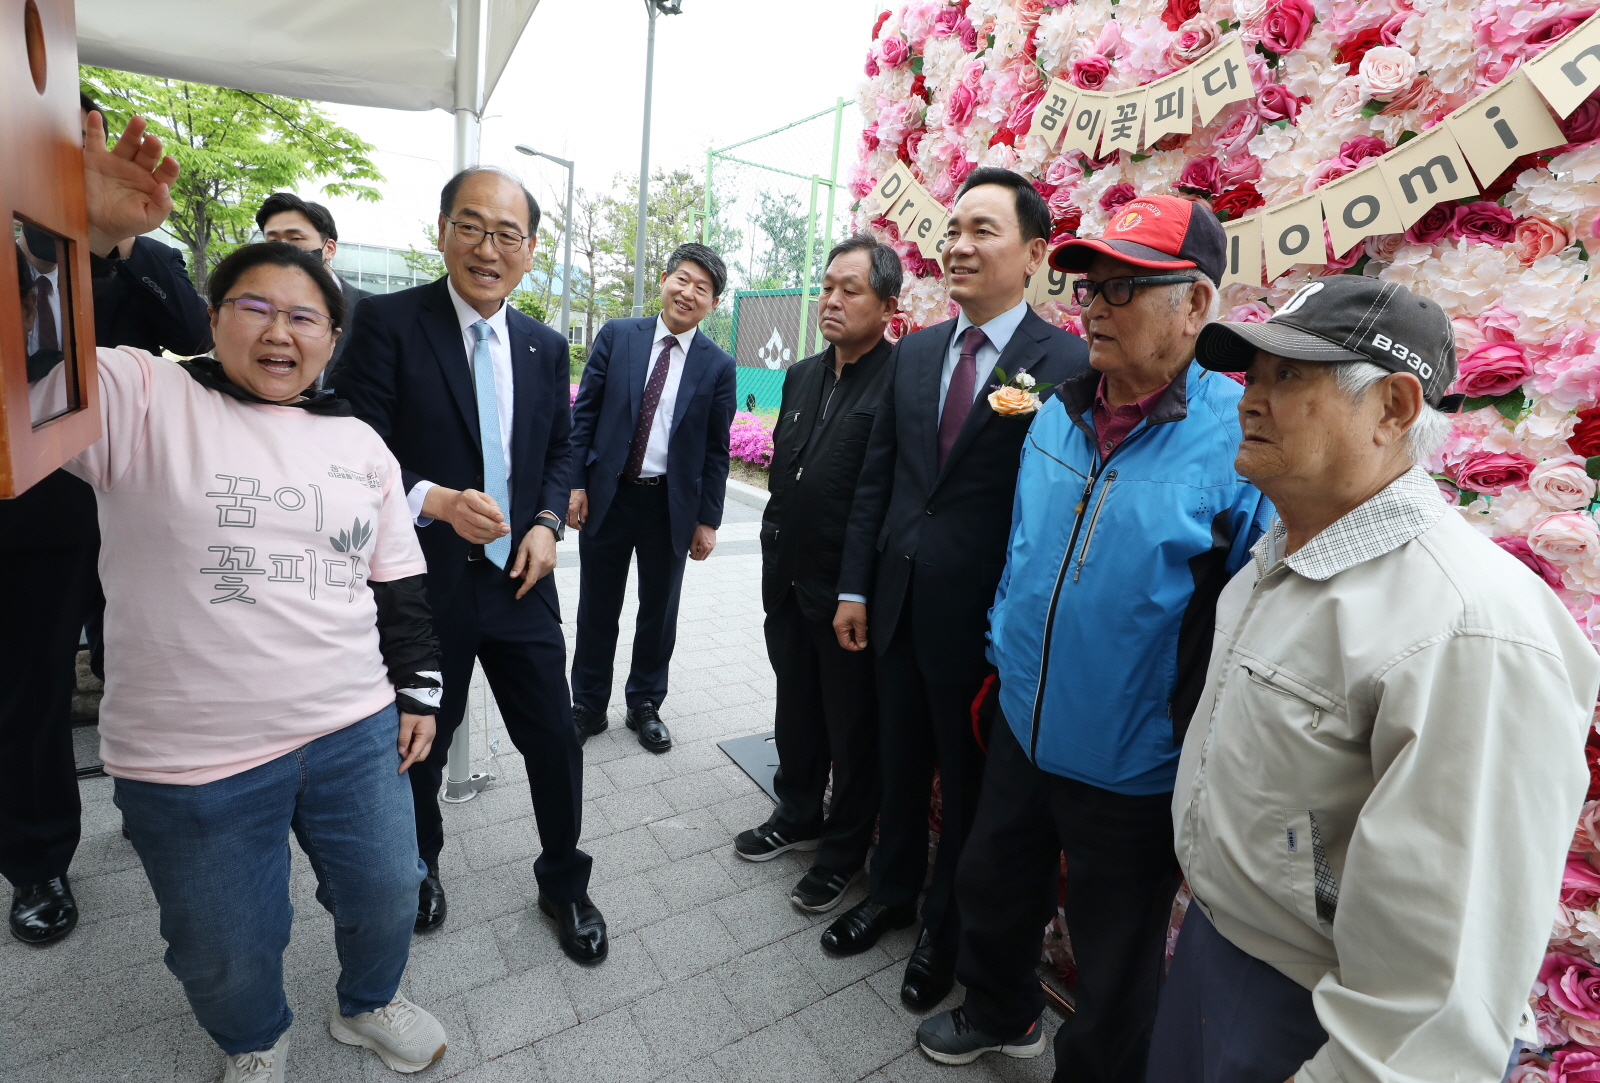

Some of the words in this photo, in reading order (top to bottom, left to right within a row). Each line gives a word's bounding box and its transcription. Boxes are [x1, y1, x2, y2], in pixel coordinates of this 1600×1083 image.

[1145, 203, 1162, 217] CLUB
[1371, 333, 1433, 380] B330
[205, 473, 324, 532] 꿈이
[200, 545, 363, 604] 꽃피다
